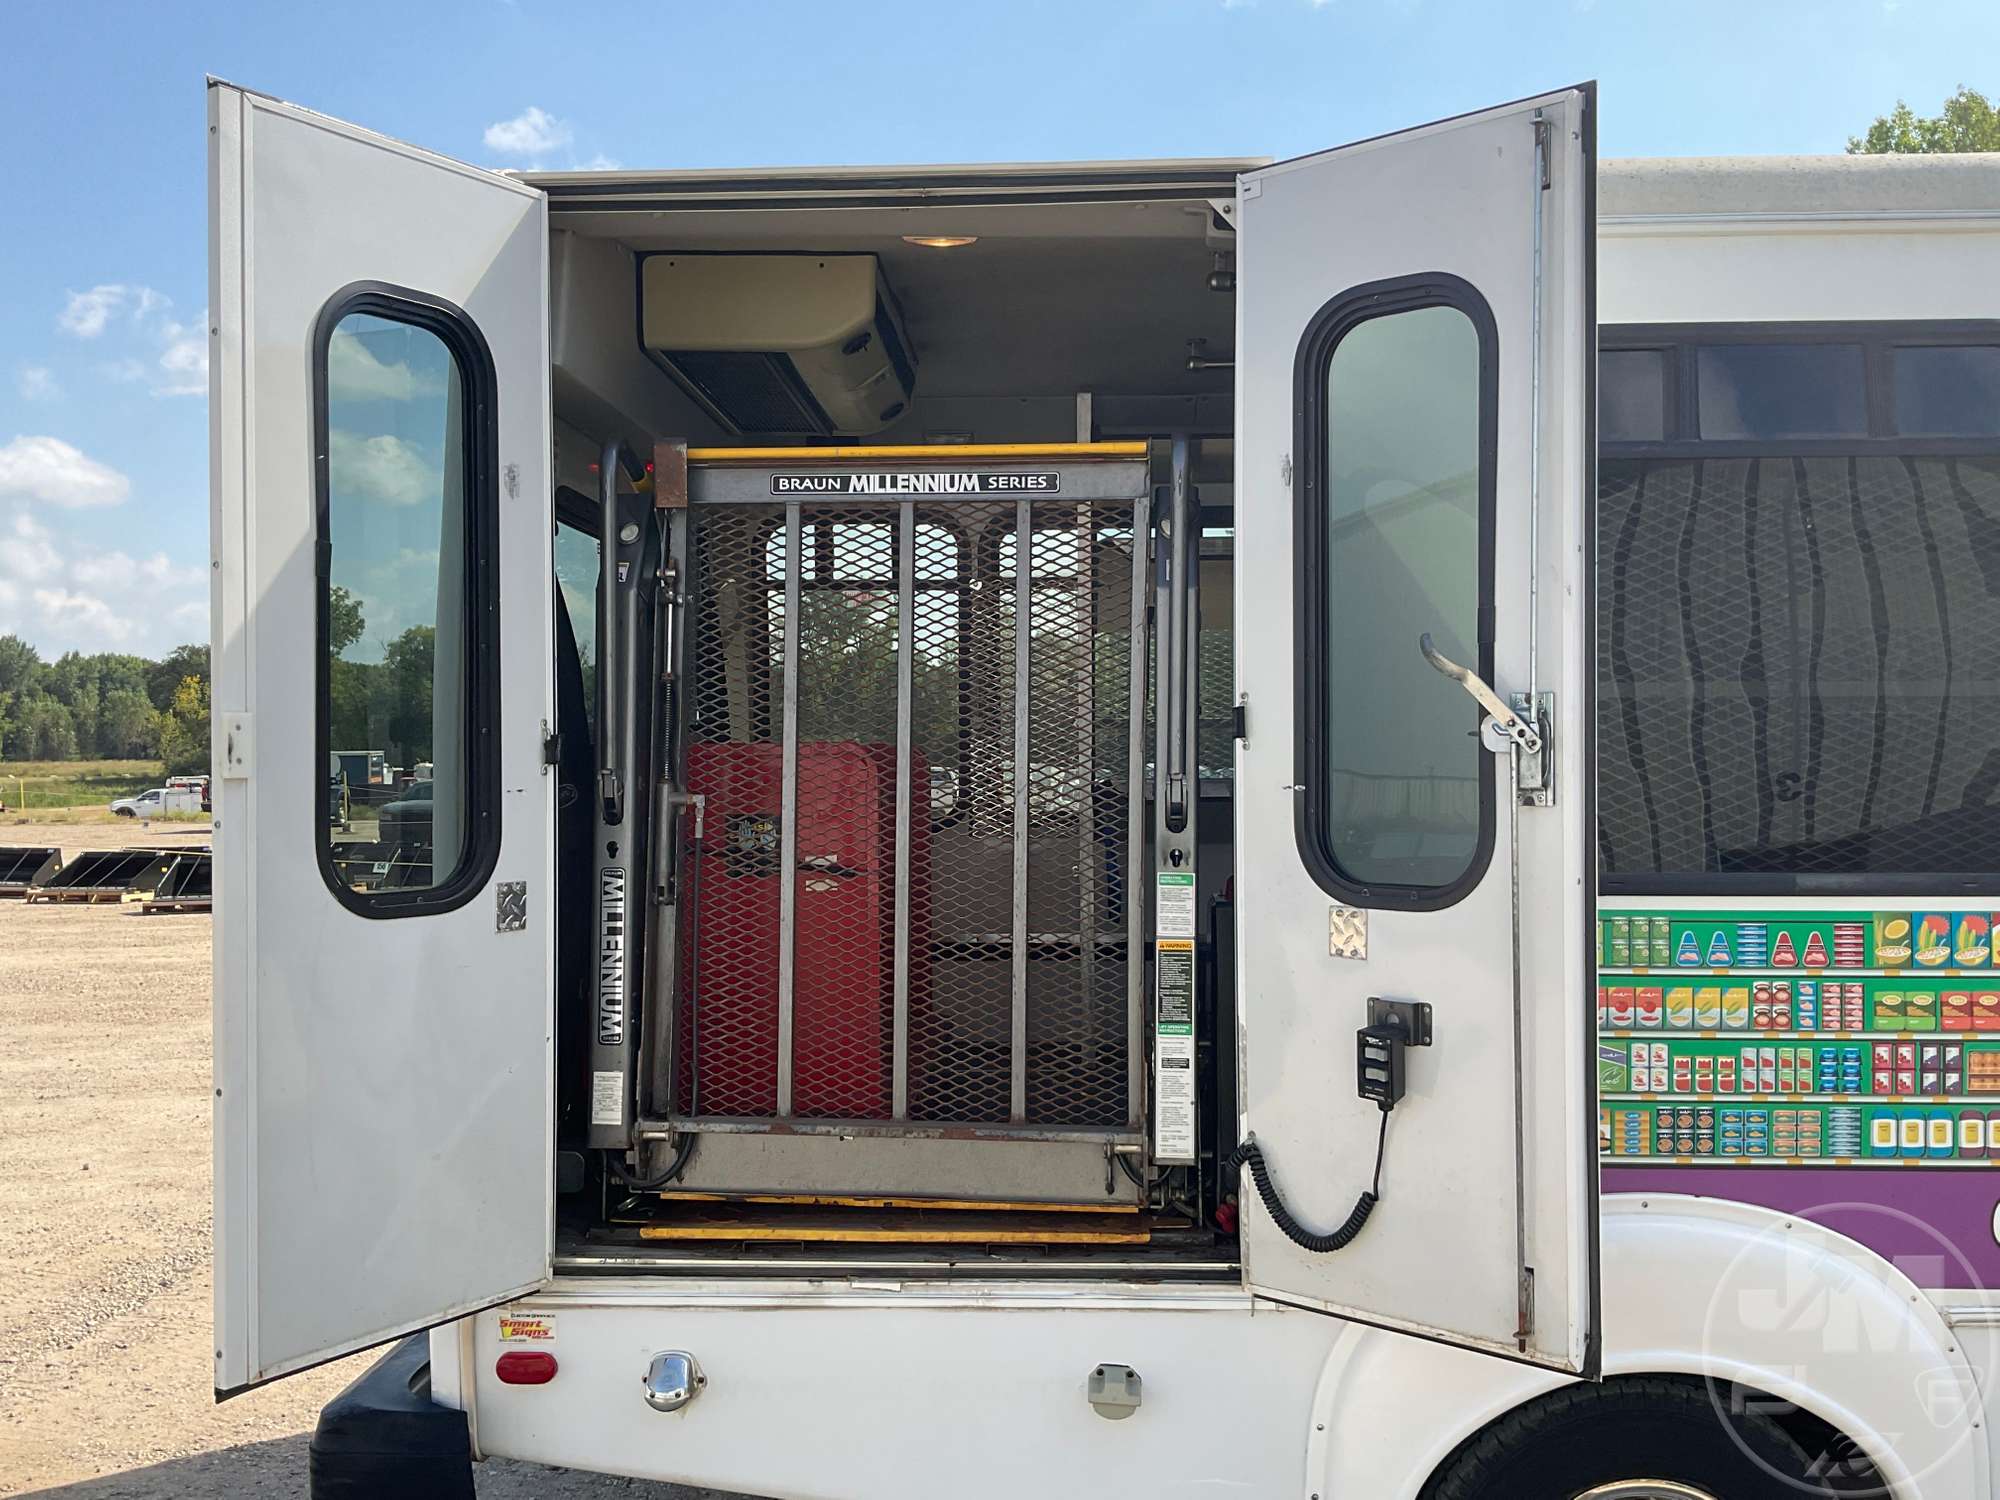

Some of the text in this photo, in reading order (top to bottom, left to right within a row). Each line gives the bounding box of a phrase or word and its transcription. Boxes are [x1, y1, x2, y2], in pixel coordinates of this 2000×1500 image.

[778, 474, 1047, 493] BRAUN MILLENNIUM SERIES
[601, 877, 623, 1035] MILLENNIUM
[500, 1319, 542, 1328] Smart
[511, 1327, 549, 1336] Signs
